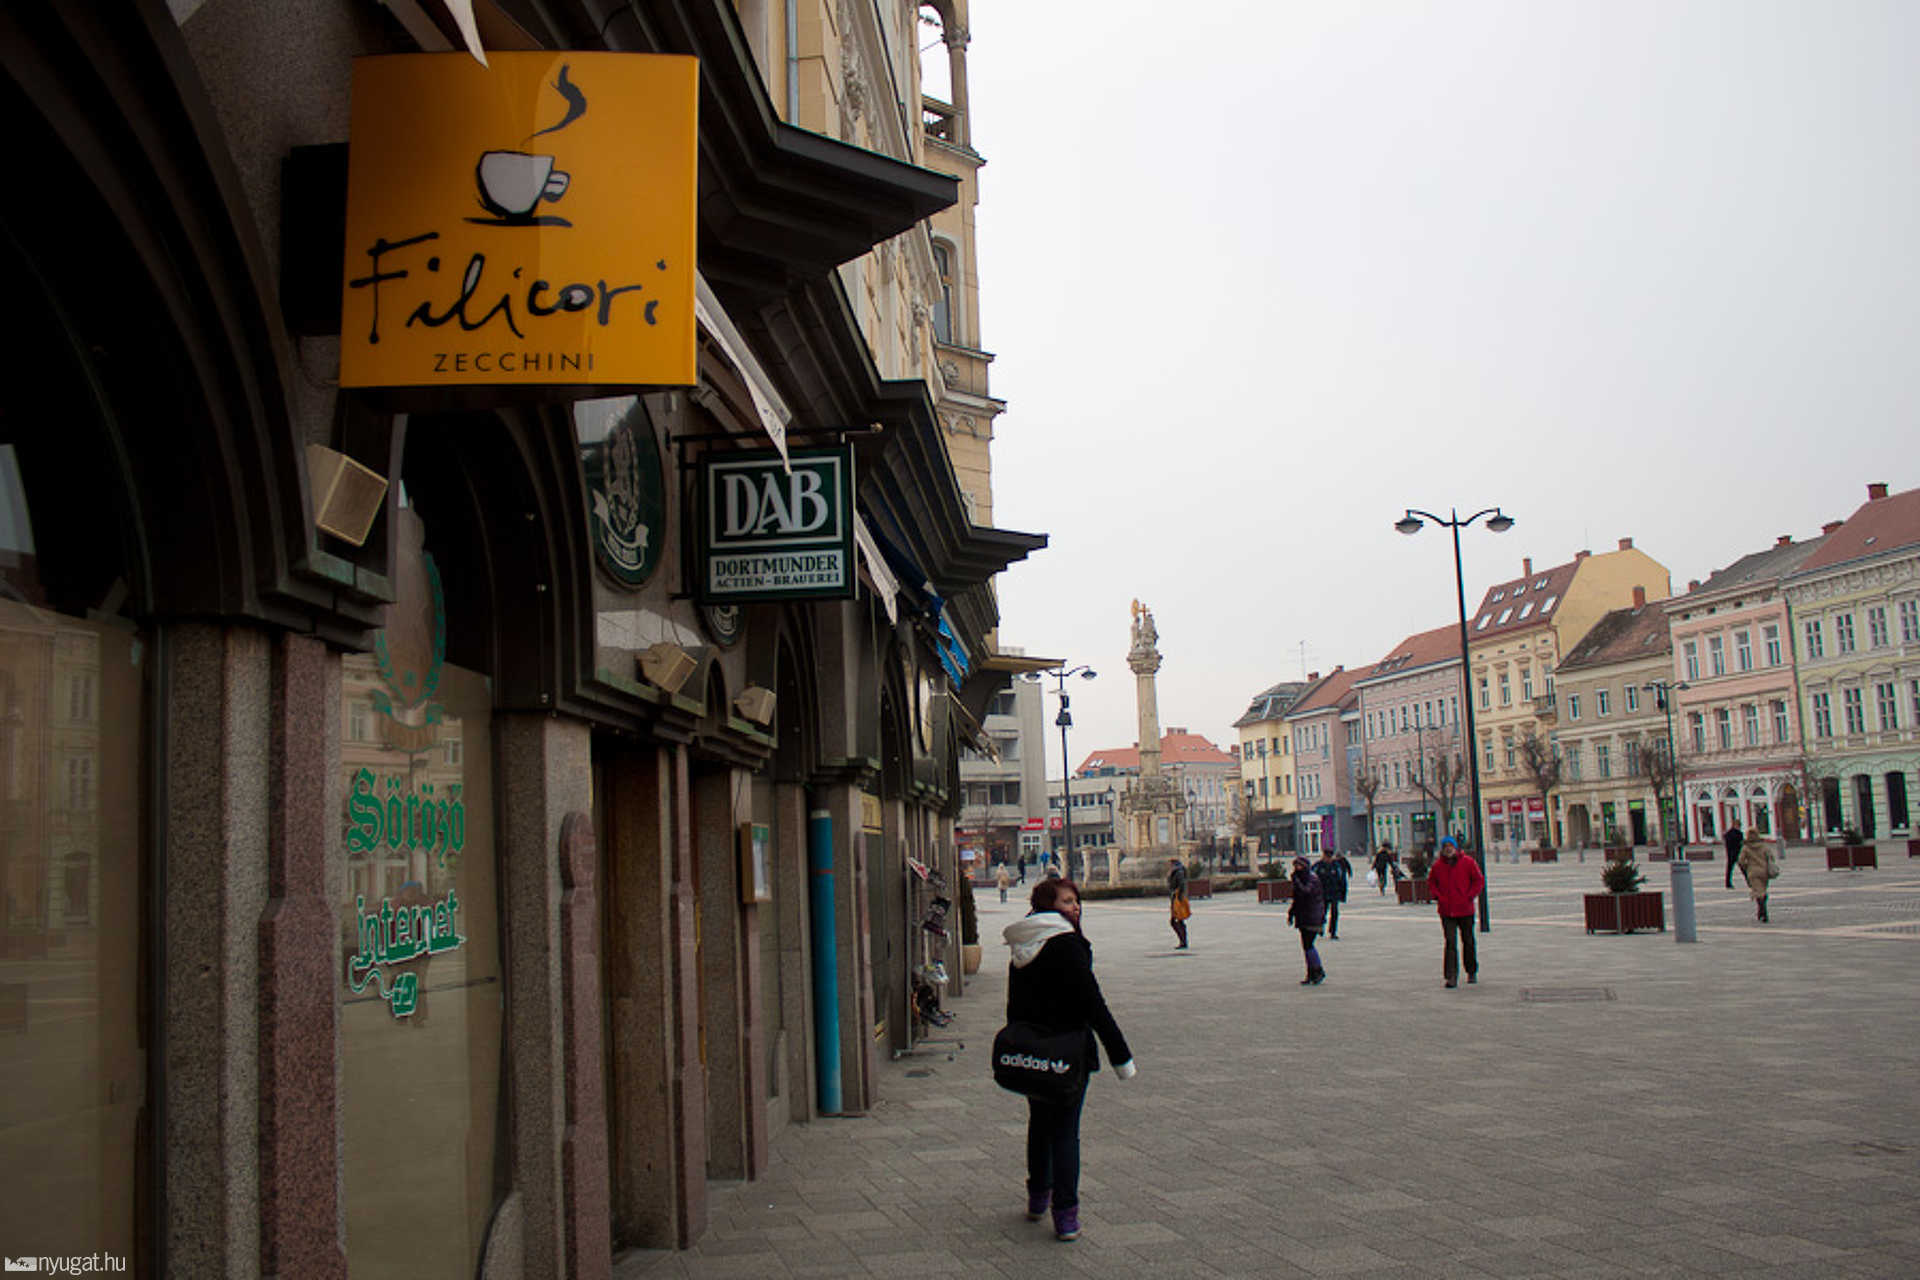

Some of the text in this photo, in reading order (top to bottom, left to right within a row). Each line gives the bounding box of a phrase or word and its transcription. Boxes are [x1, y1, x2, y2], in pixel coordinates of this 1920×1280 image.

[350, 232, 666, 344] Filicori
[433, 353, 593, 372] ZECCHINI
[722, 469, 828, 536] DAB
[715, 554, 838, 576] DORTMUNDER
[1001, 1053, 1049, 1071] adidas
